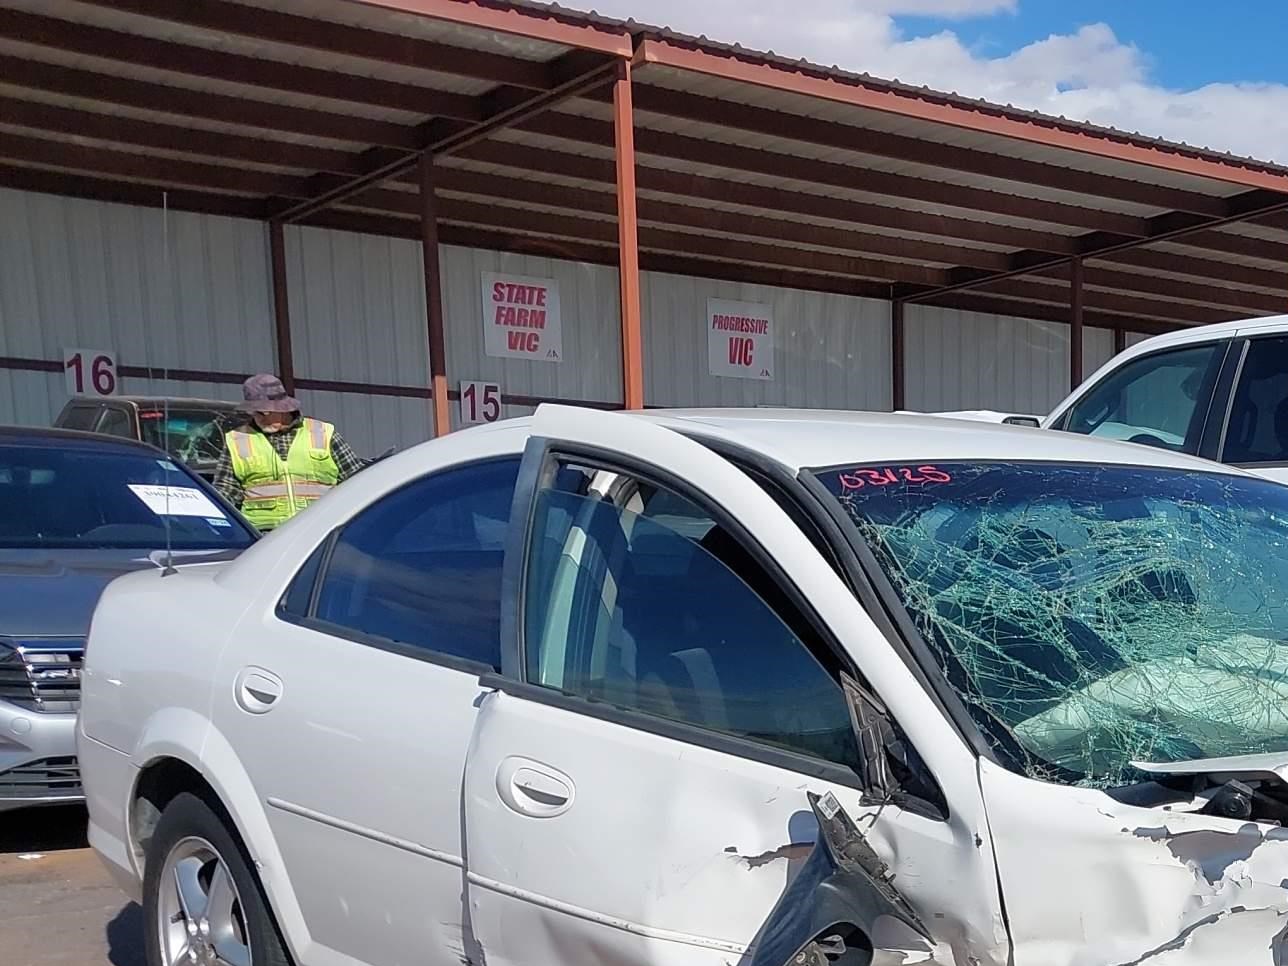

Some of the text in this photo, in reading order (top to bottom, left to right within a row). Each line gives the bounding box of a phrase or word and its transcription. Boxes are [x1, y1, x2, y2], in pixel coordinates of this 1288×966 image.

[492, 281, 547, 307] STATE
[494, 306, 547, 330] FARM
[712, 314, 769, 335] PROGRESSIVE
[507, 330, 540, 353] VIC
[728, 336, 754, 367] VIC
[66, 352, 116, 396] 16
[463, 383, 500, 423] 15
